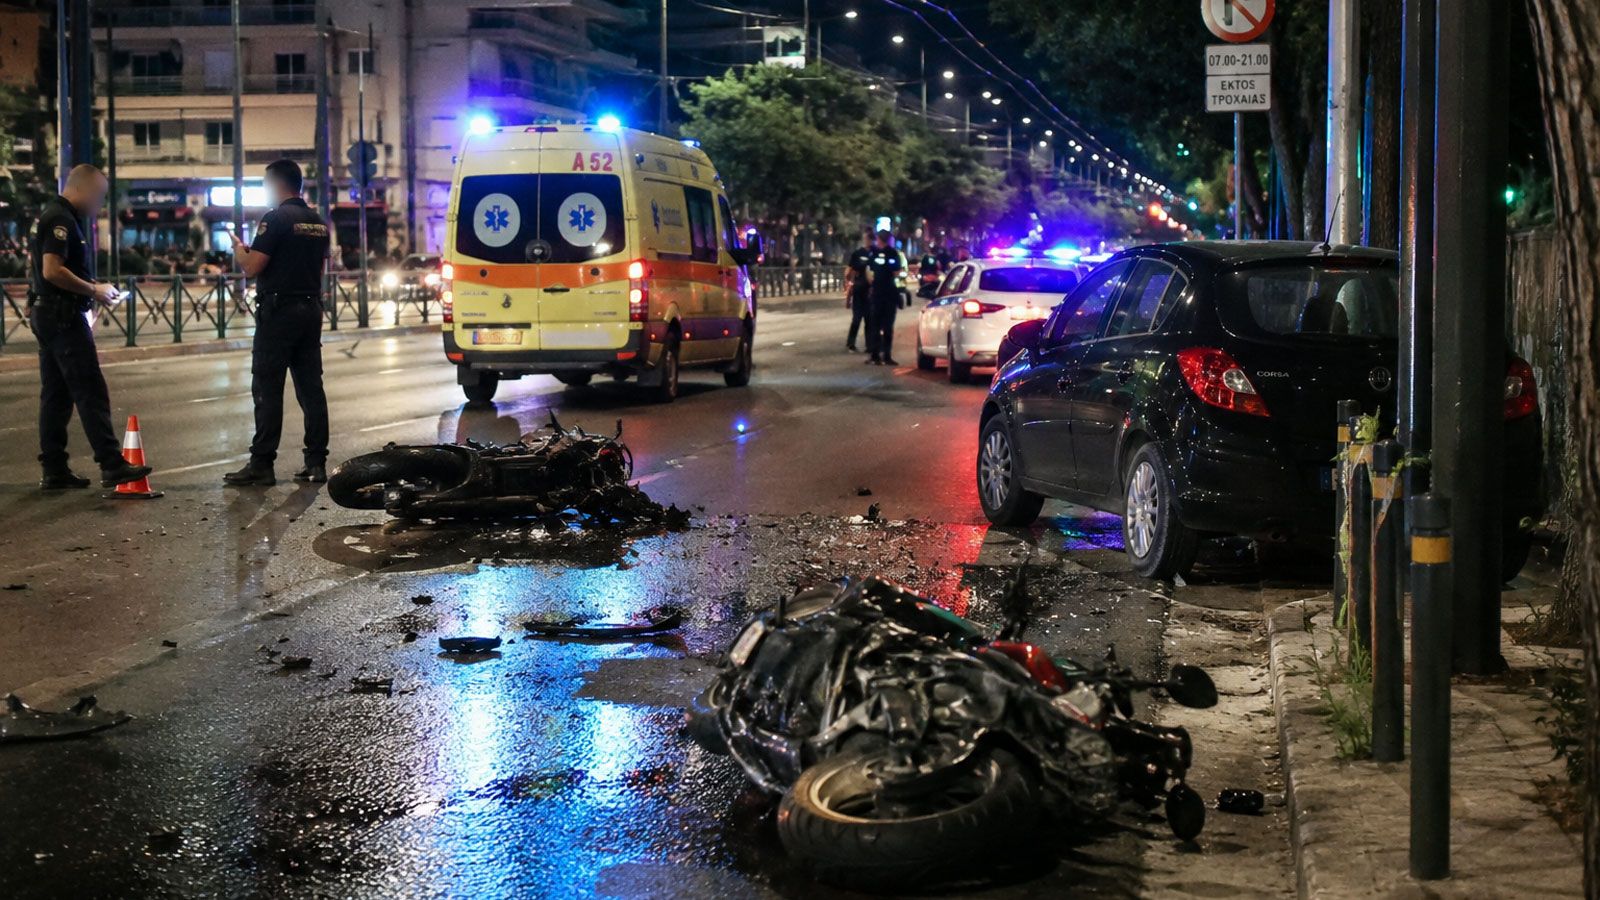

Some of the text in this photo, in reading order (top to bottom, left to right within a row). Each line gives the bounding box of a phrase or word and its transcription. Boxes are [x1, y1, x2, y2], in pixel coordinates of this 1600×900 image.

[1208, 53, 1269, 67] 07.00-21.00
[589, 151, 614, 172] 52
[1256, 370, 1290, 378] CORSA
